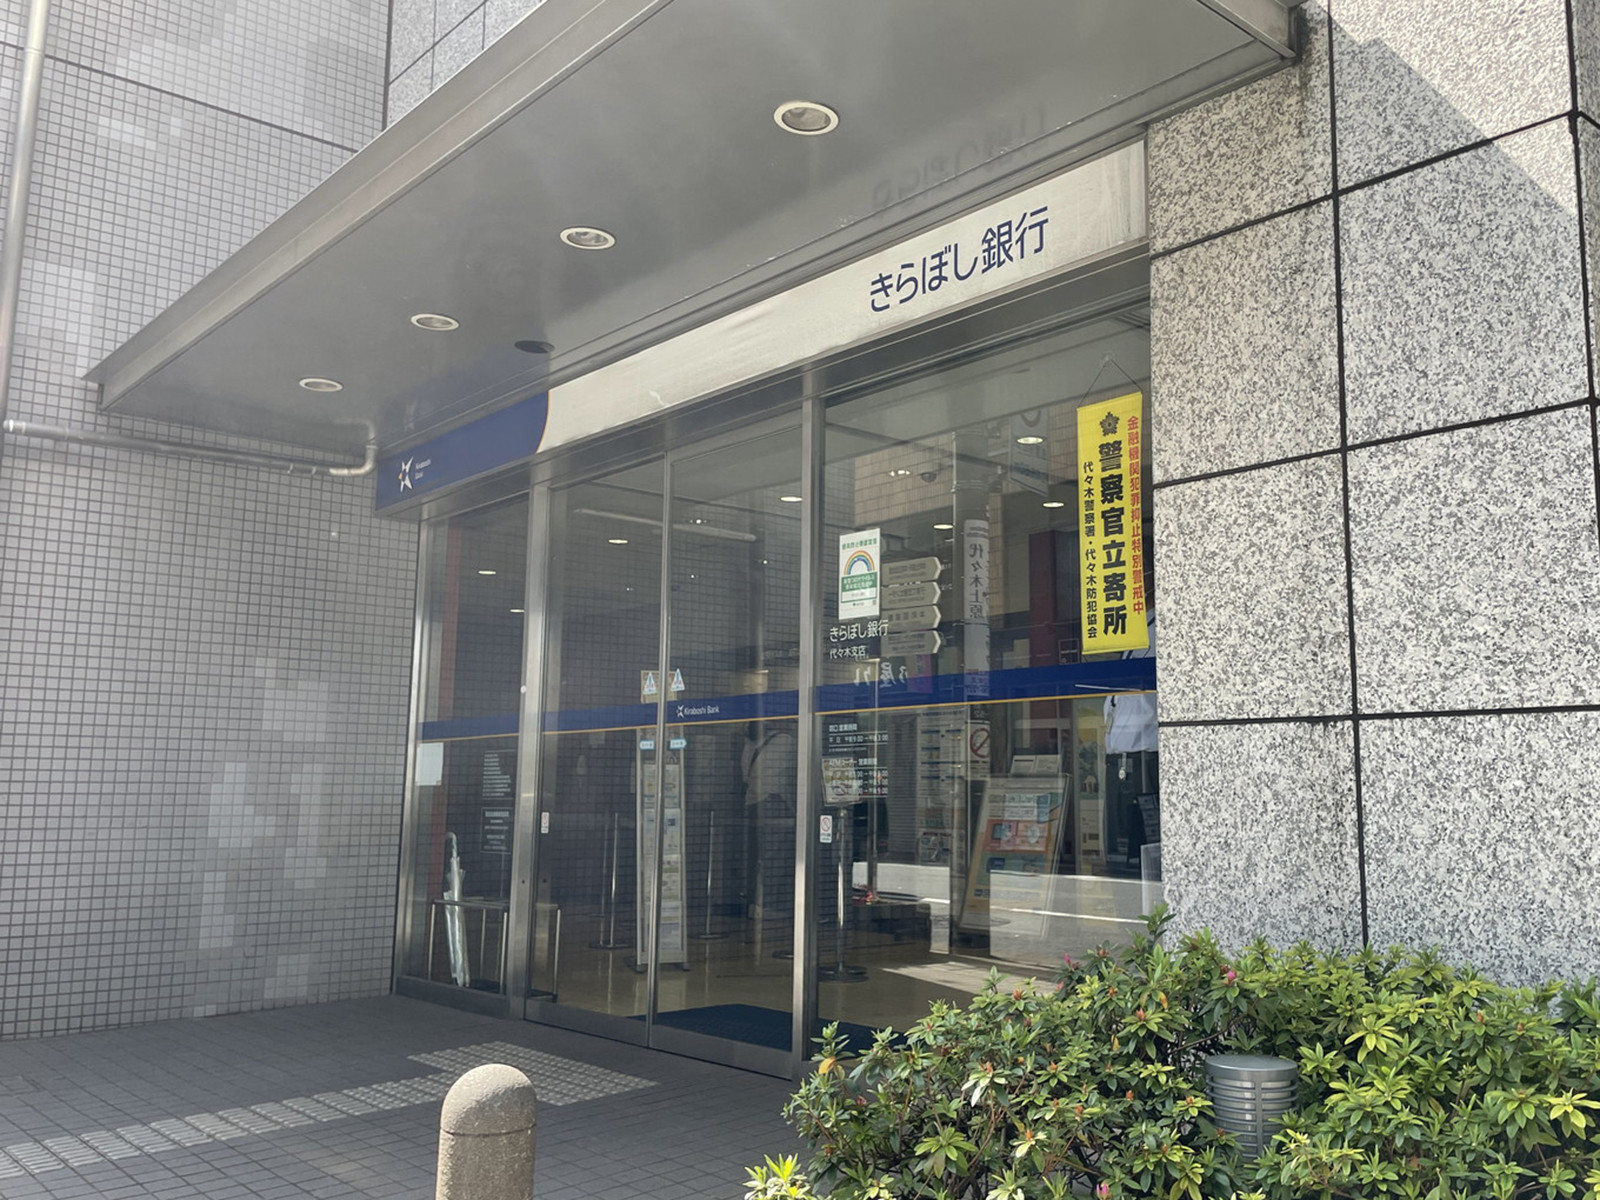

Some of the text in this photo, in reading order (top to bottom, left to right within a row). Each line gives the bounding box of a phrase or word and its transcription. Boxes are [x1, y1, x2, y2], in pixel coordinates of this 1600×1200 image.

[870, 206, 1049, 312] きらぼし銀行
[1083, 461, 1098, 639] 代々木警察署・代々木防犯協会
[1098, 440, 1127, 636] 警察官立寄所
[1127, 415, 1144, 615] 金融機関犯罪抑止特別警戒中
[829, 619, 889, 642] きらぼし銀行
[829, 645, 867, 660] 代々木支店
[684, 705, 720, 716] Kiraboshi Bank
